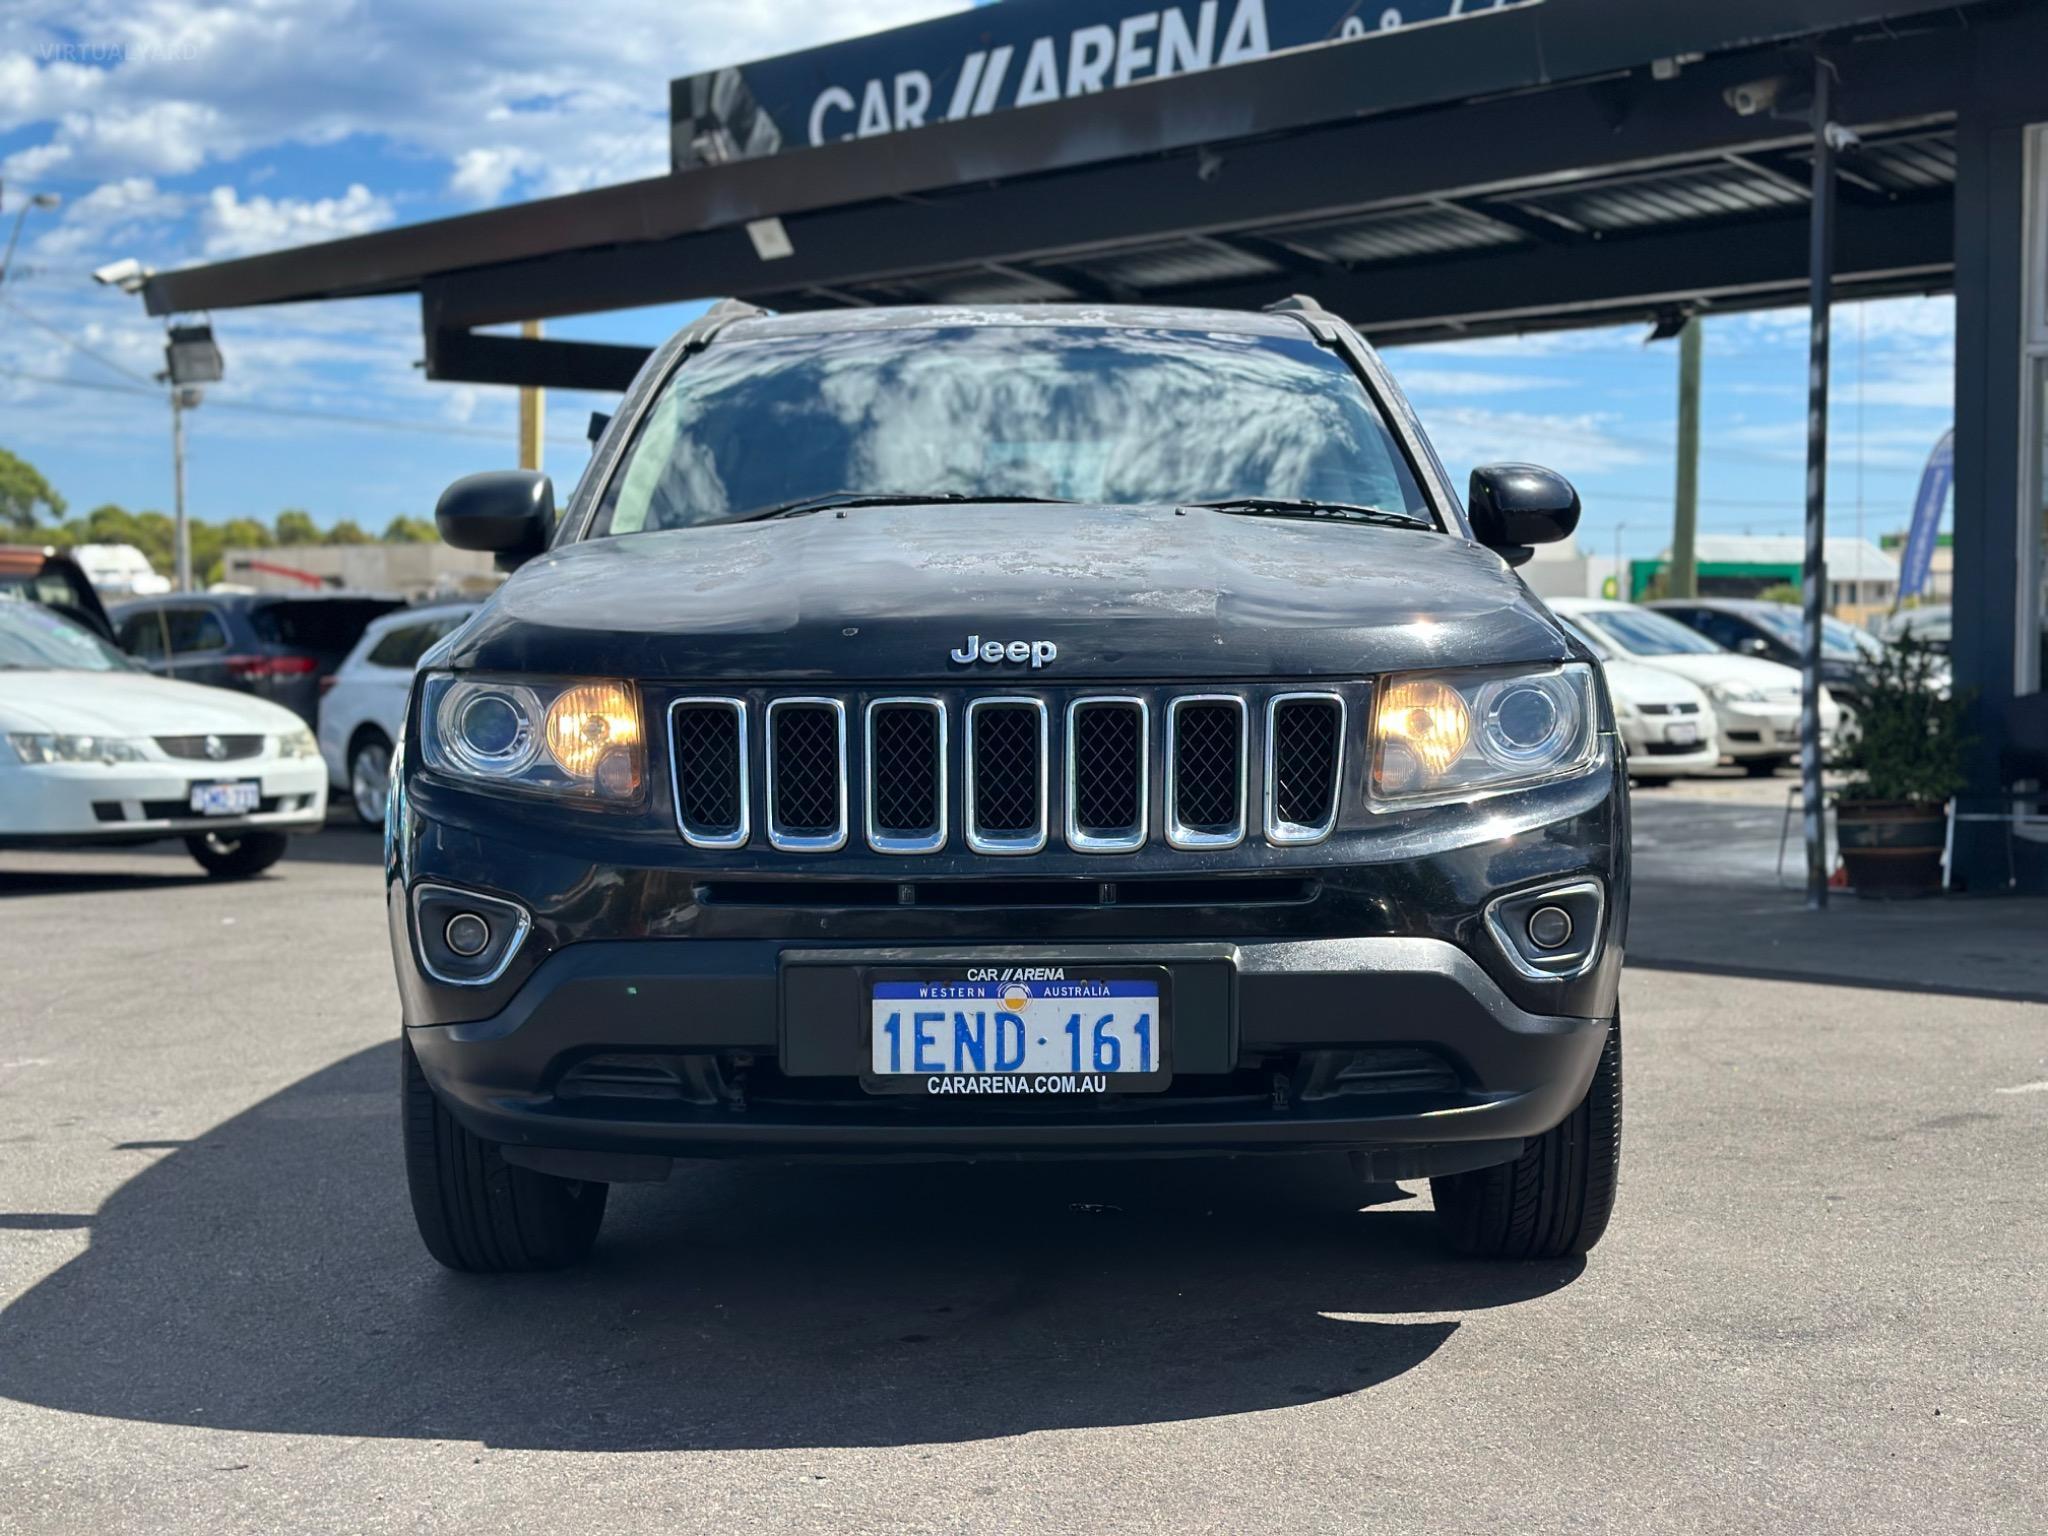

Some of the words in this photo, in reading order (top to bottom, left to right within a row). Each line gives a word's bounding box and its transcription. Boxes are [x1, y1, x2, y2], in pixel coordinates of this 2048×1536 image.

[808, 71, 932, 147] CAR
[951, 635, 1057, 668] Jeep
[967, 968, 998, 981] CAR
[919, 987, 986, 998] WESTERN
[1043, 986, 1111, 997] AUSTRALIA
[927, 1076, 1107, 1094] CARARENA.COM.AU
